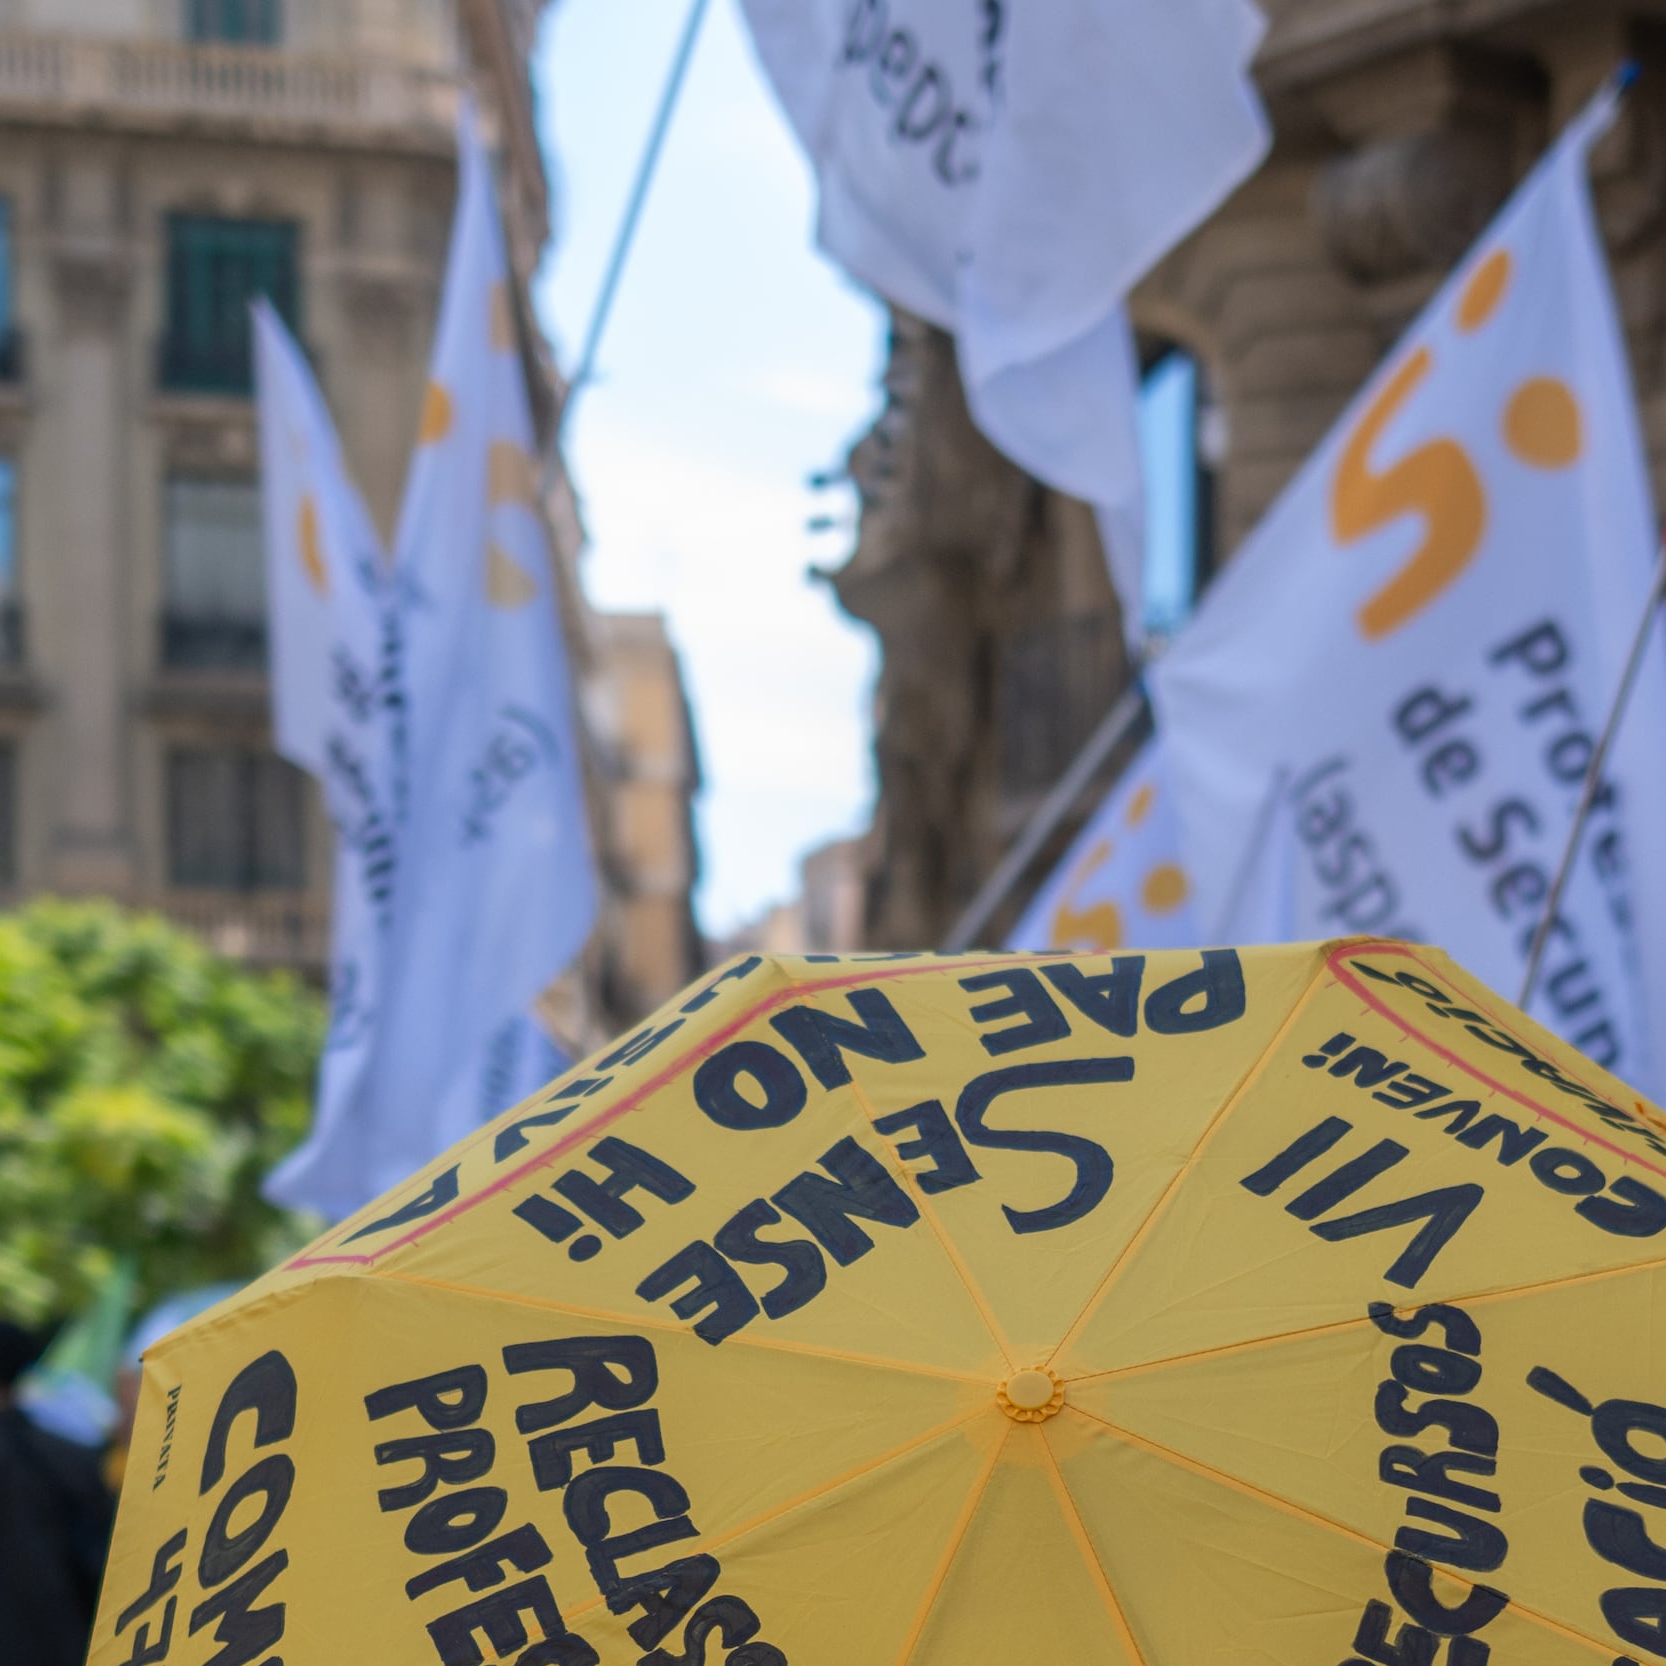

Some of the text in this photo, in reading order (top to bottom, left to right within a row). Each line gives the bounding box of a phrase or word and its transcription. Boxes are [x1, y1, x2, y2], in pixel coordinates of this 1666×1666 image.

[1391, 682, 1625, 1072] de Secun
[692, 987, 927, 1132] NO
[957, 948, 1247, 1058] PAE
[635, 1055, 1135, 1348] SENSE
[1240, 1115, 1484, 1289] VII
